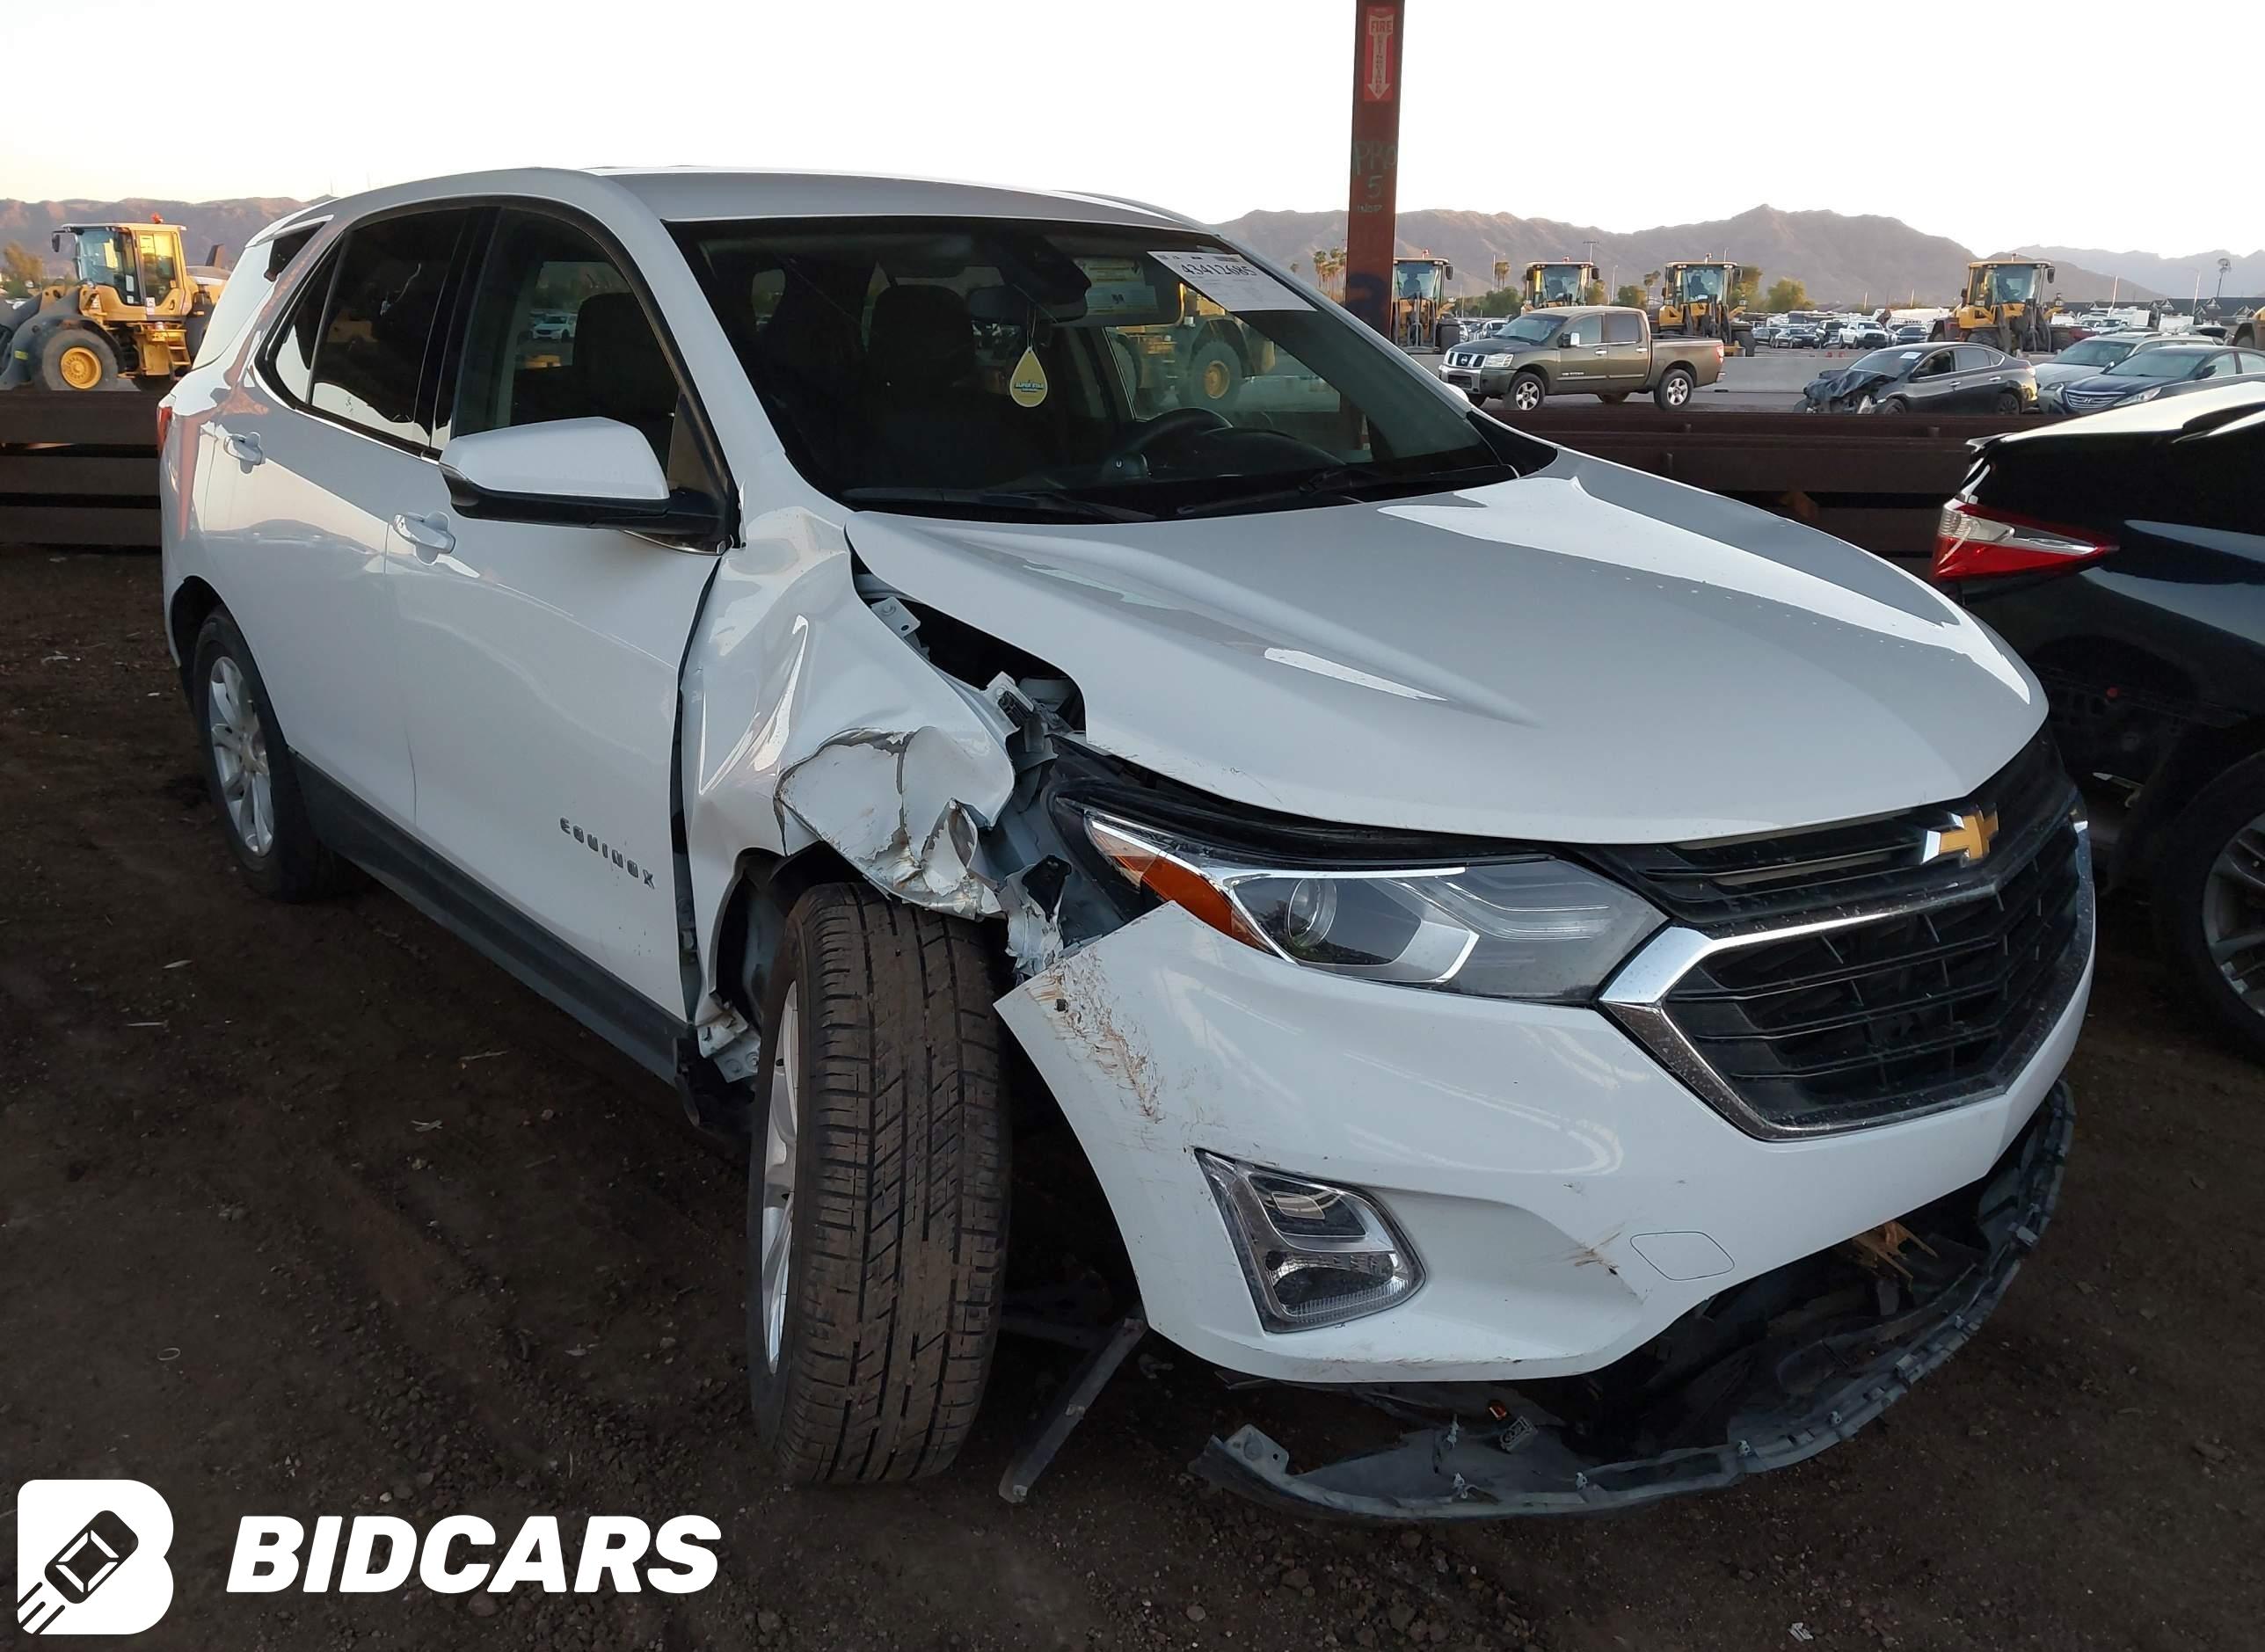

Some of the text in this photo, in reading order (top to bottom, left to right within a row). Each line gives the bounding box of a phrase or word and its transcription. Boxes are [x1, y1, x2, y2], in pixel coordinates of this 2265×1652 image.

[1371, 20, 1393, 33] FIRE
[1181, 264, 1257, 276] 43412685
[559, 817, 655, 890] EQUINOX
